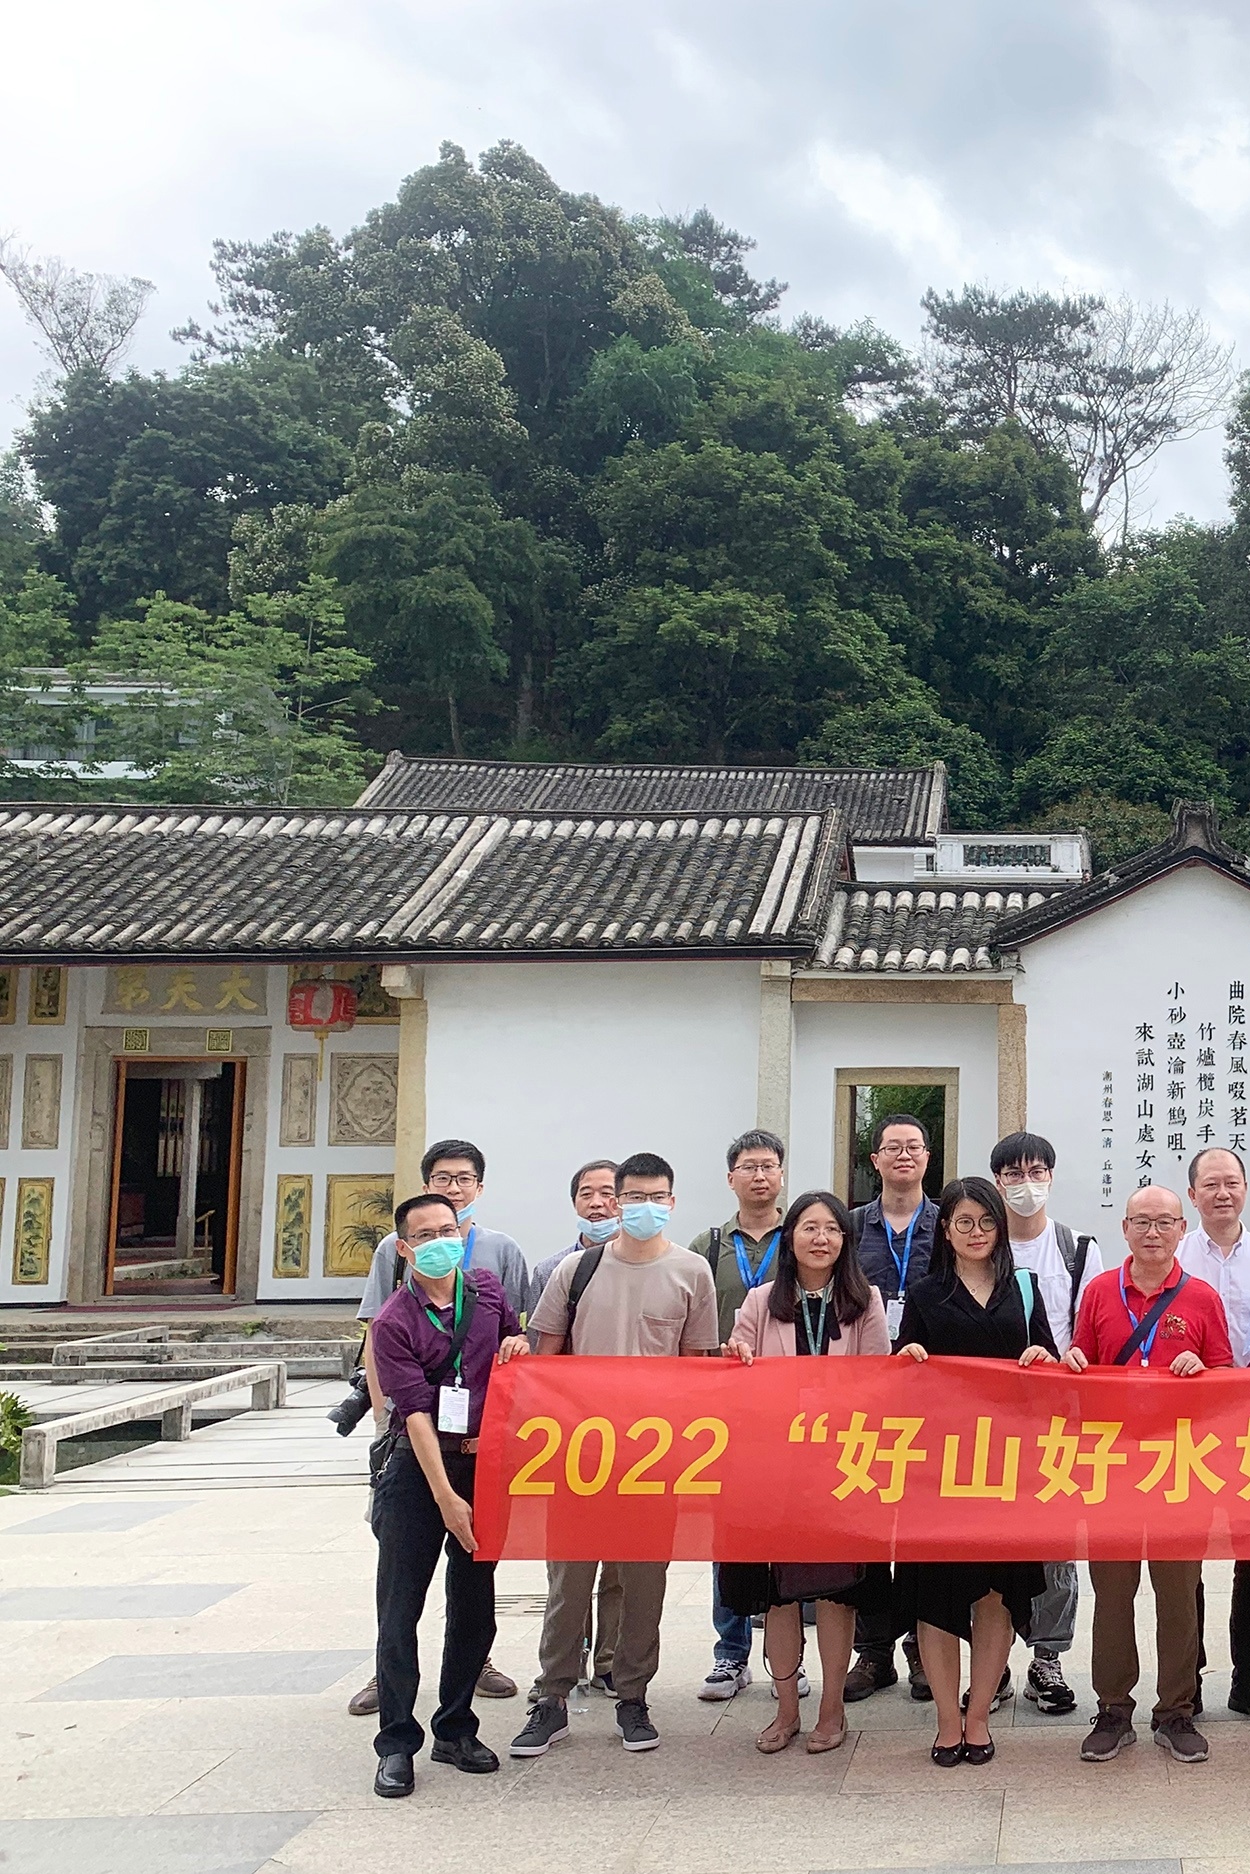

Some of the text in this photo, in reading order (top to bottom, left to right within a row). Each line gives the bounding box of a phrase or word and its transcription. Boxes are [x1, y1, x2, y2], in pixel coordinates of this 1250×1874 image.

[1195, 1021, 1217, 1153] 竹爐欖炭手
[508, 1416, 729, 1496] 2022
